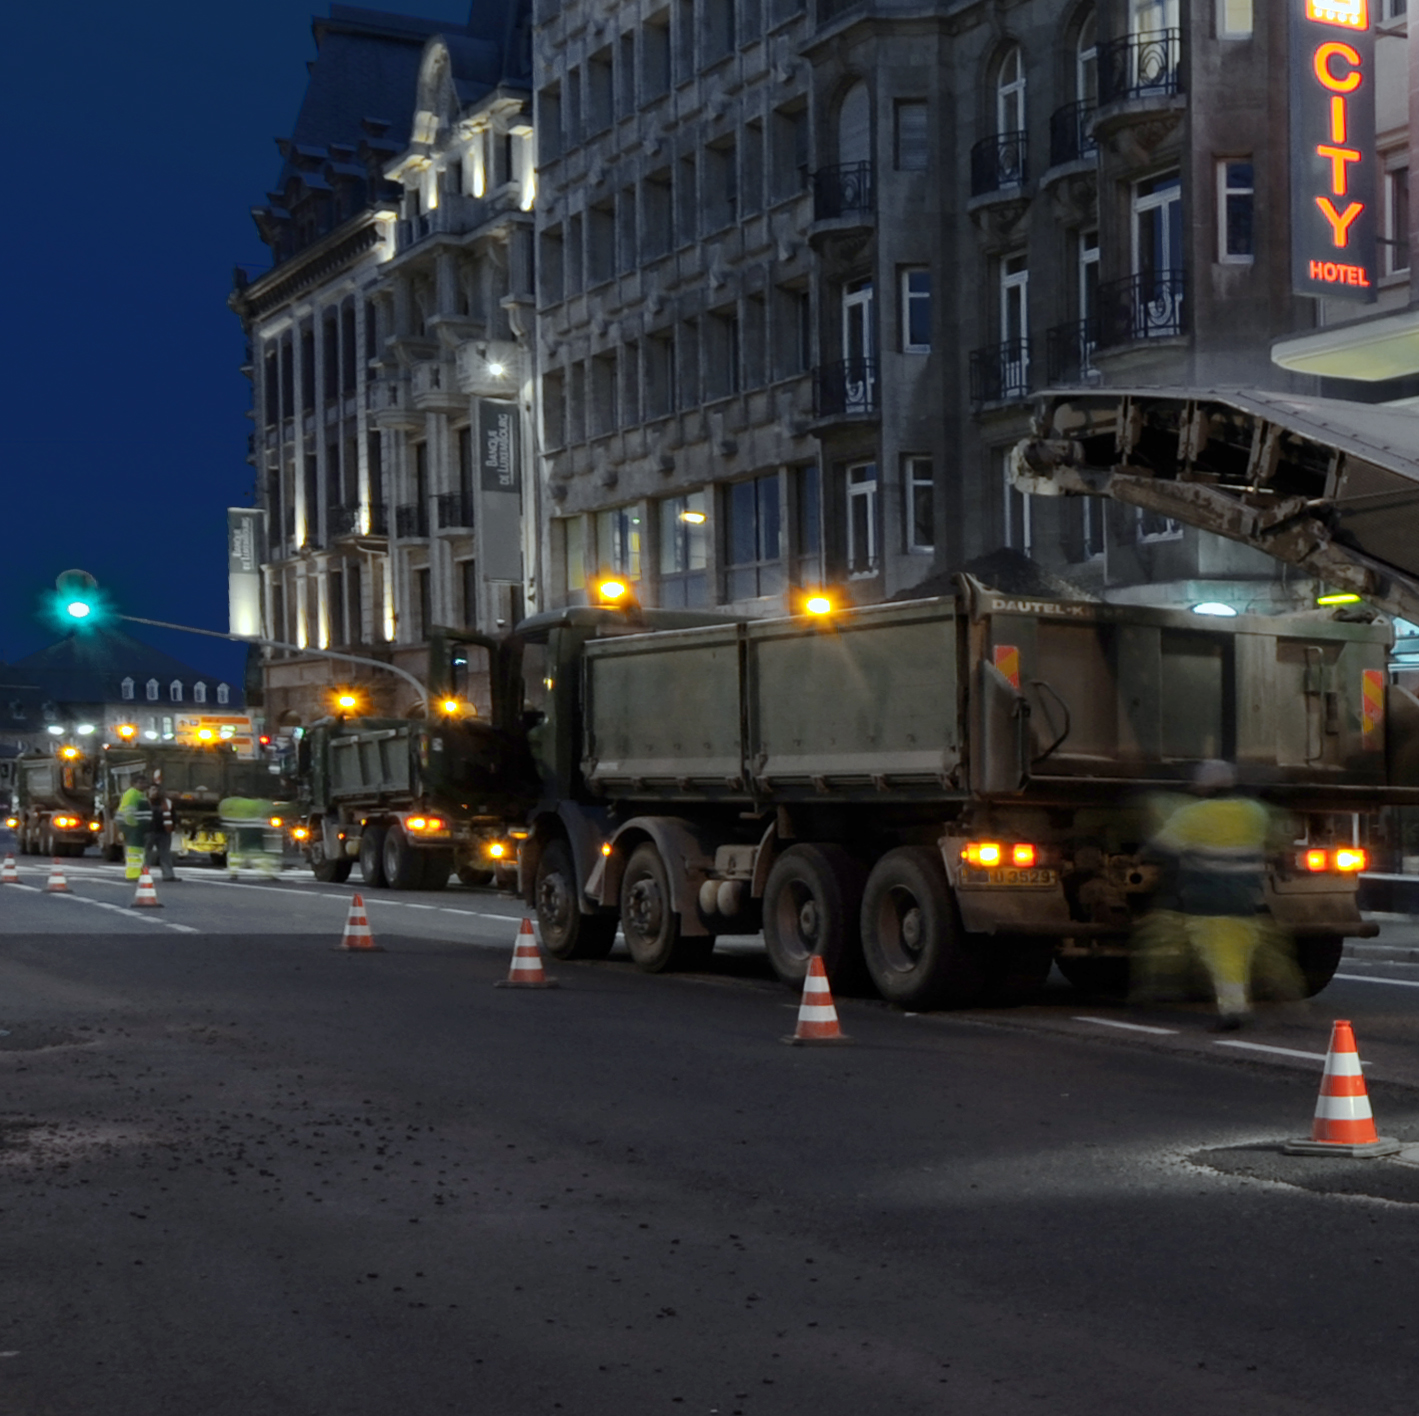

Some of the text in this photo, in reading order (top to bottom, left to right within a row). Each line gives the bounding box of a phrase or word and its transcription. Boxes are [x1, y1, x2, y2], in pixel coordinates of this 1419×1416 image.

[1313, 40, 1366, 249] CITY
[1309, 259, 1371, 287] HOTEL
[1008, 870, 1051, 884] 3529
